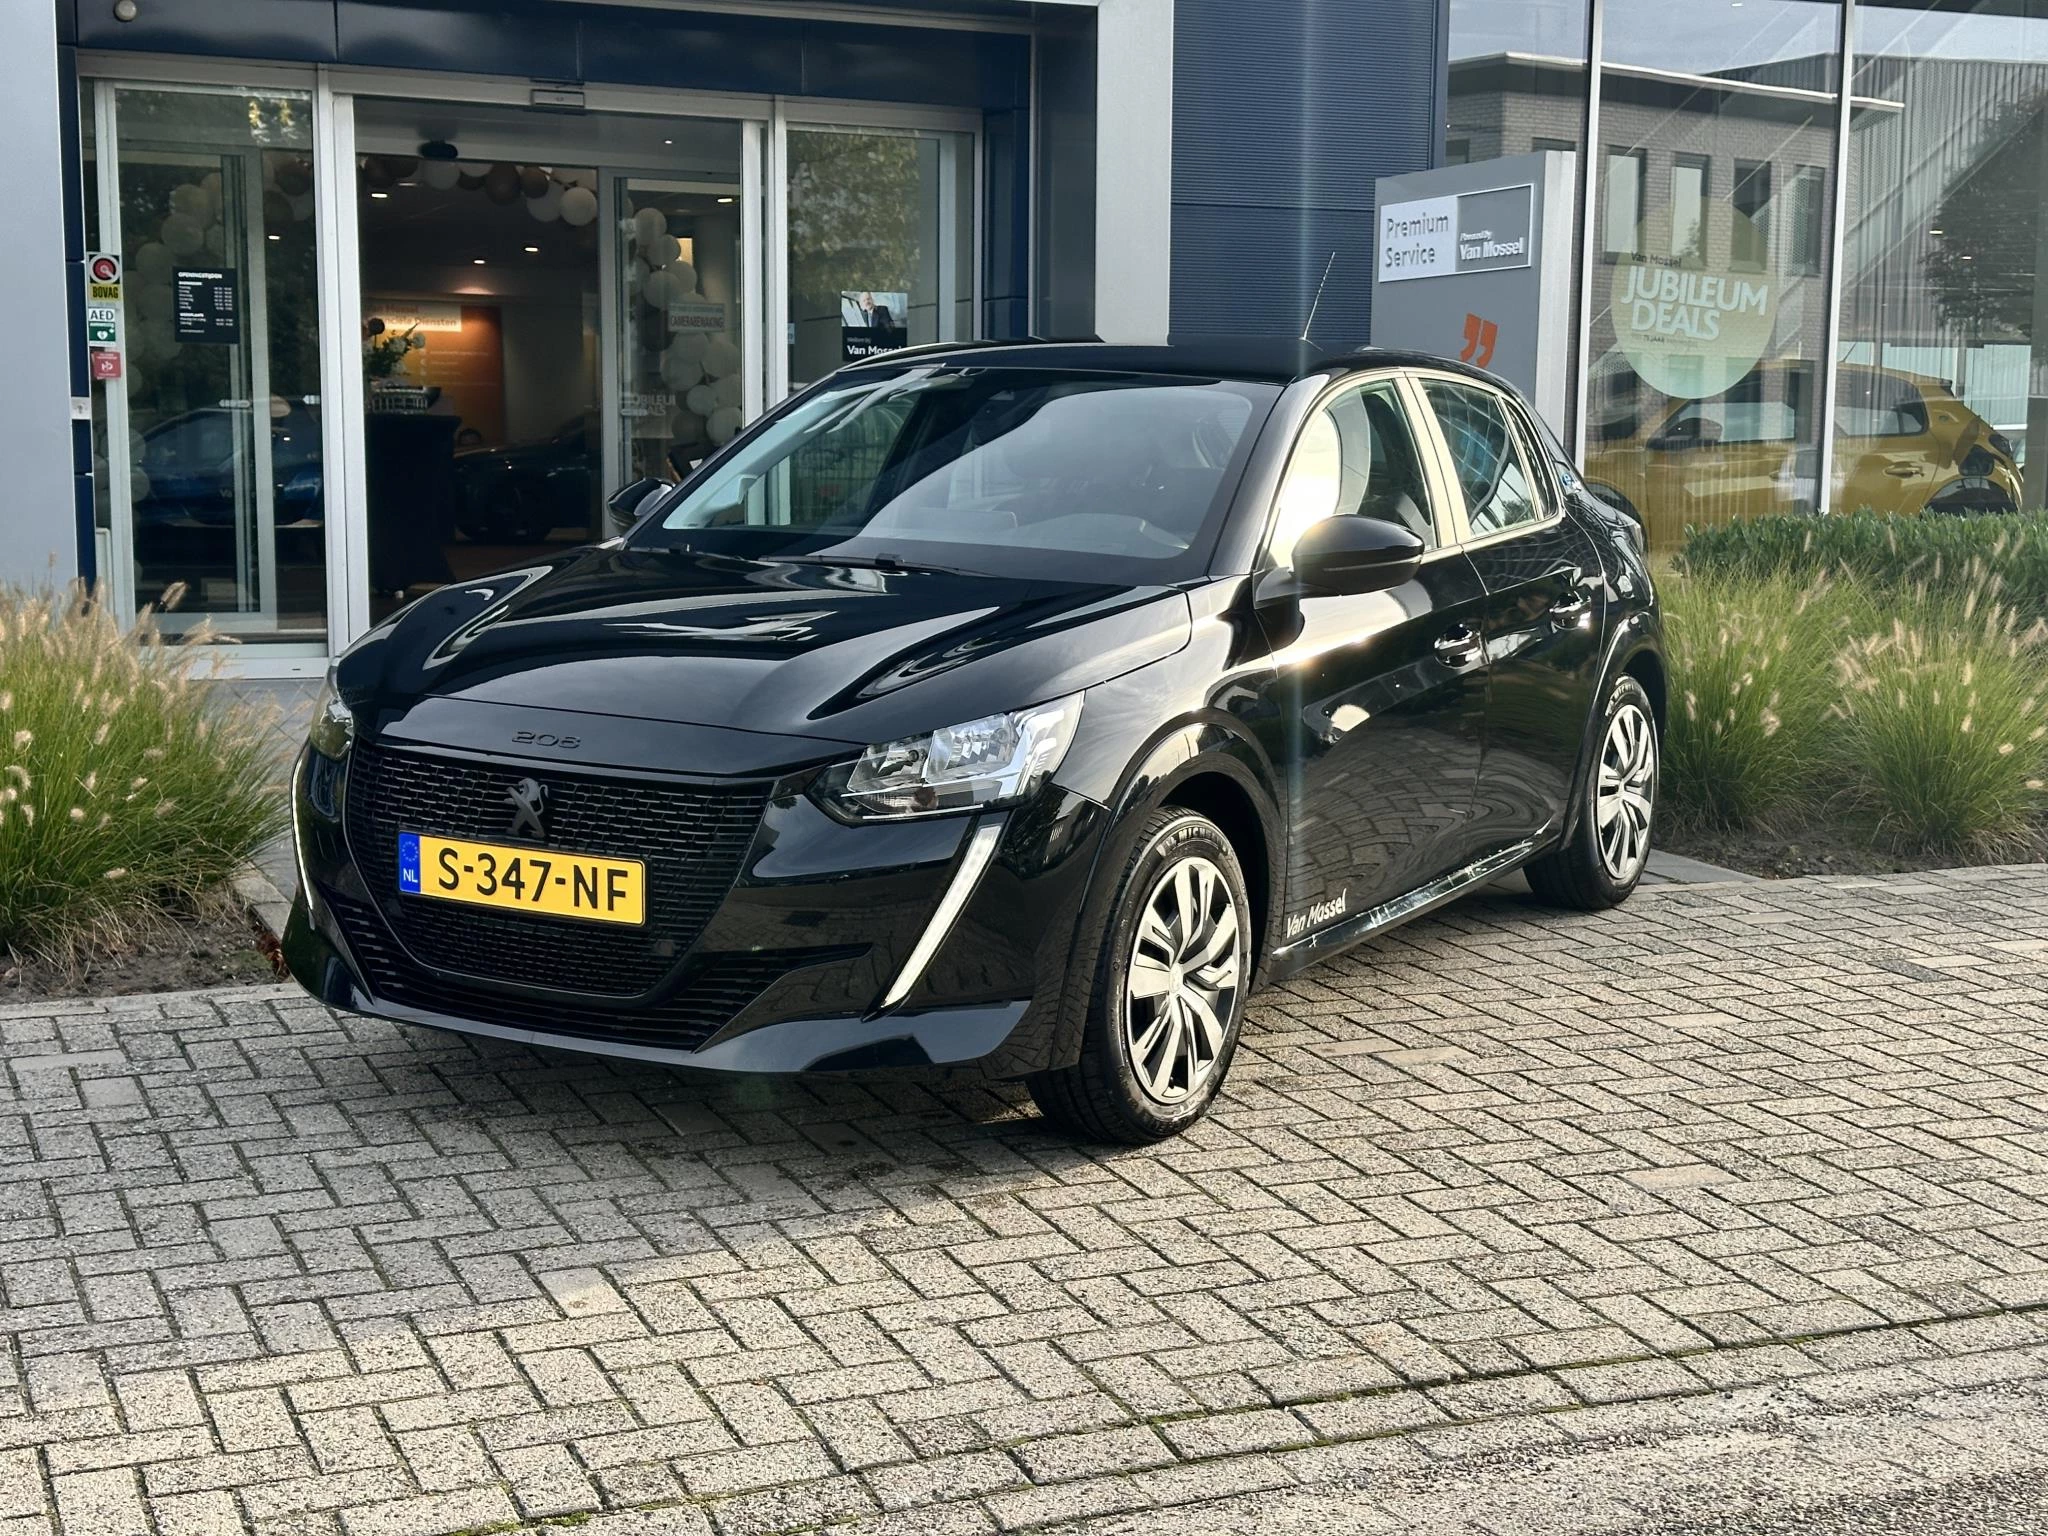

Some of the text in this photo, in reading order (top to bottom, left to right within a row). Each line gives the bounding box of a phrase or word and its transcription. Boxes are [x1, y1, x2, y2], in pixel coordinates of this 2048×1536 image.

[1386, 212, 1449, 239] Premium
[1385, 243, 1436, 268] Service
[1460, 237, 1524, 261] Van Mossel
[1632, 251, 1682, 267] Van Mossel
[92, 286, 119, 299] BOVAG
[1620, 265, 1769, 316] JUBILEUM
[91, 310, 114, 321] AED
[1631, 299, 1721, 341] DEALS
[847, 345, 902, 355] Van Mos
[511, 731, 582, 749] 208
[403, 868, 418, 883] NL
[438, 847, 629, 912] S-347-NF
[1286, 887, 1347, 939] Van Mossel
